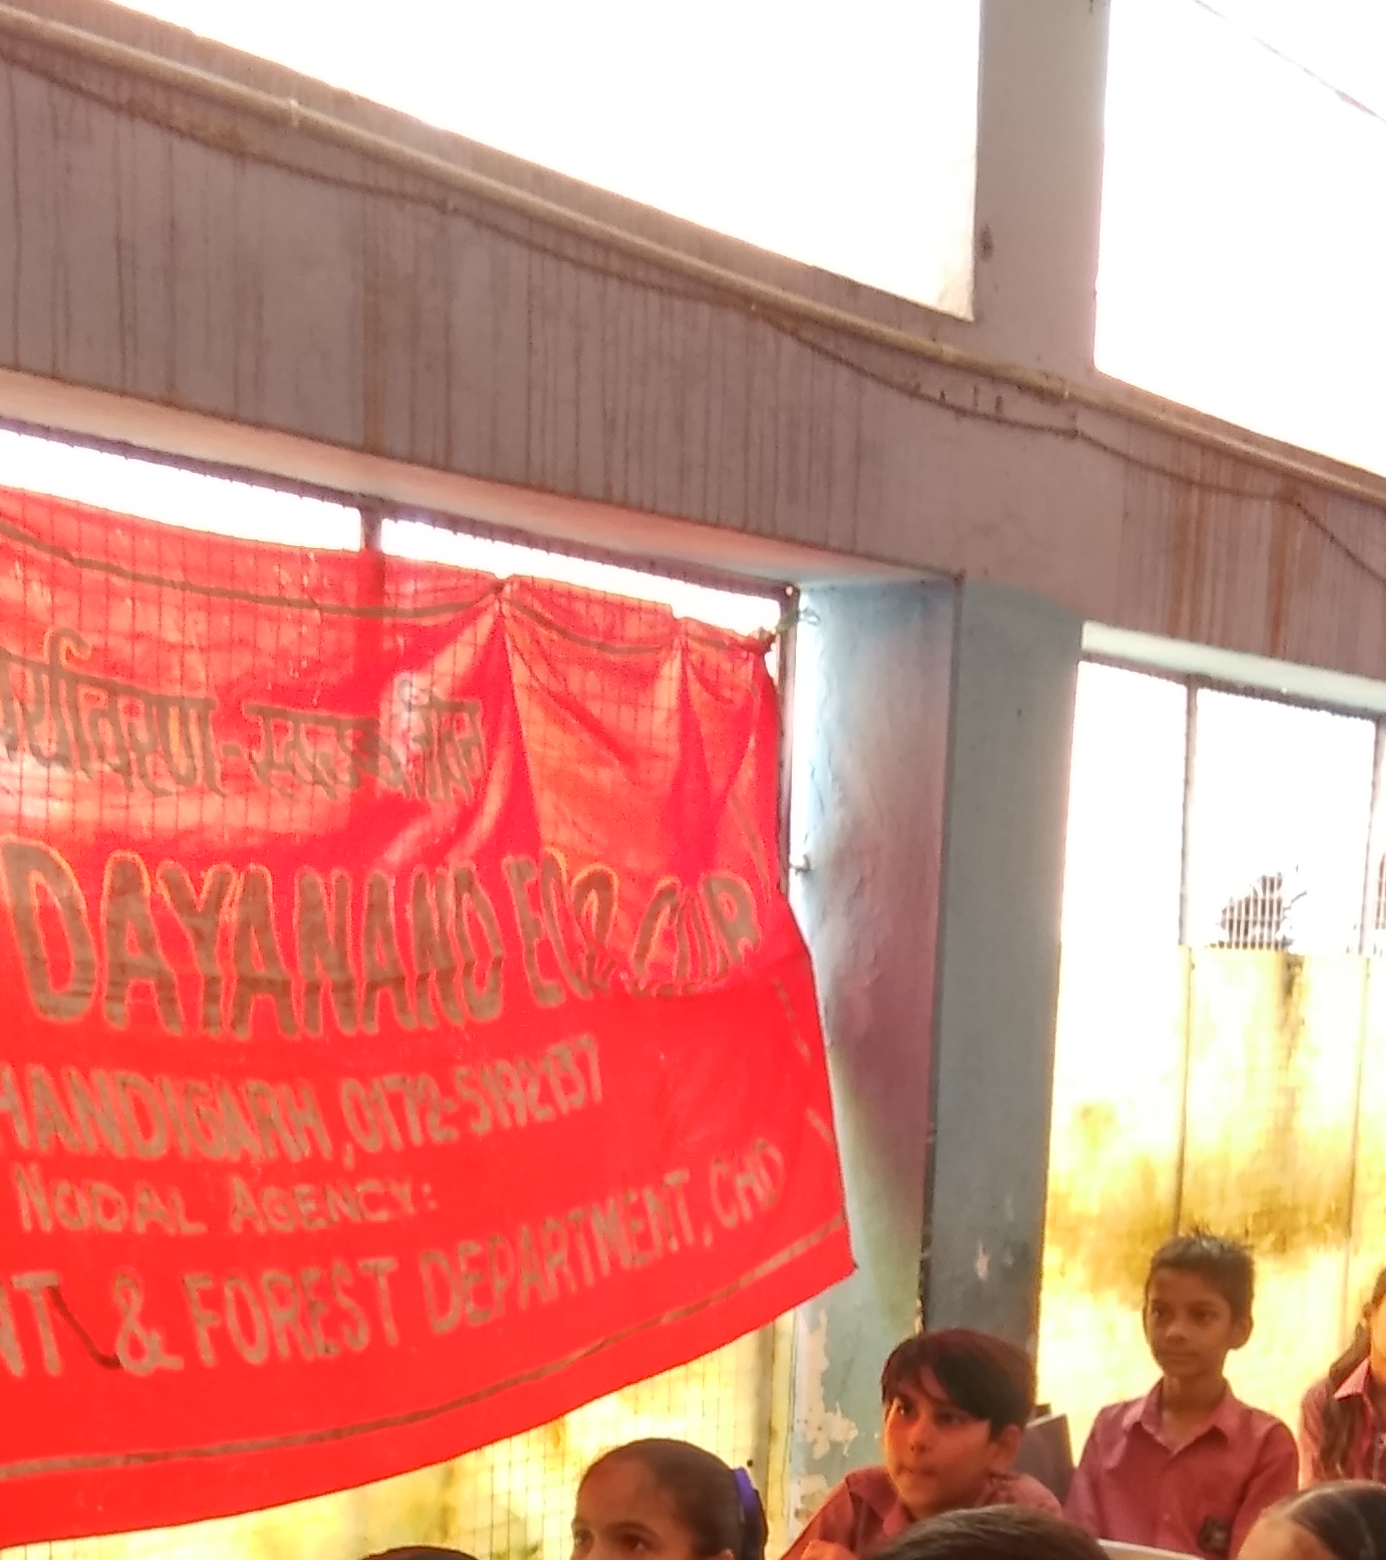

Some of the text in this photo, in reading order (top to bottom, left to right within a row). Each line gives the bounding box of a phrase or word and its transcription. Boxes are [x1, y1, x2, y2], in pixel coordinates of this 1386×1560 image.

[3, 836, 503, 1036] DAYANAND
[14, 1164, 437, 1235] NODAL AGENCY:
[115, 1266, 184, 1377] &
[182, 1256, 399, 1367] FOREST
